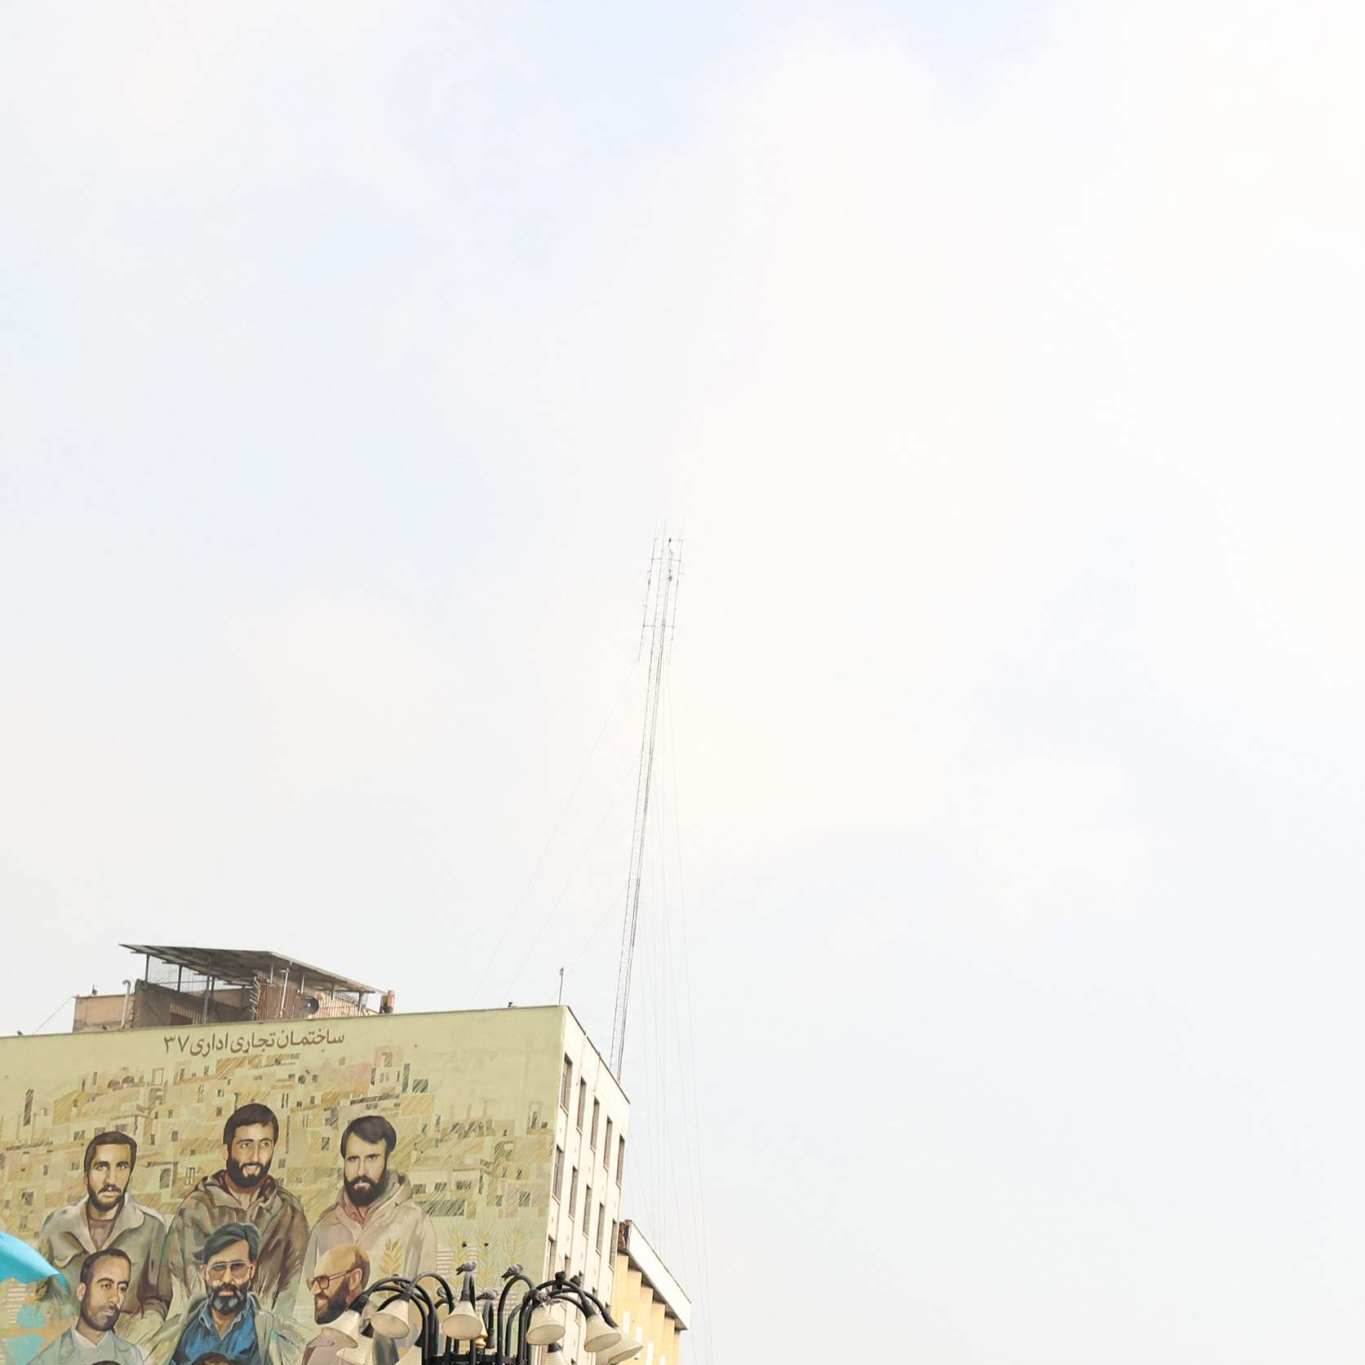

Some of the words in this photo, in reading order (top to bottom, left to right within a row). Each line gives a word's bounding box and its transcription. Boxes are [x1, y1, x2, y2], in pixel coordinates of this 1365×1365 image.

[163, 1035, 190, 1055] ۳۷
[190, 1032, 229, 1057] اداری
[231, 1031, 276, 1053] تجاری
[278, 1028, 345, 1053] ساختمان
